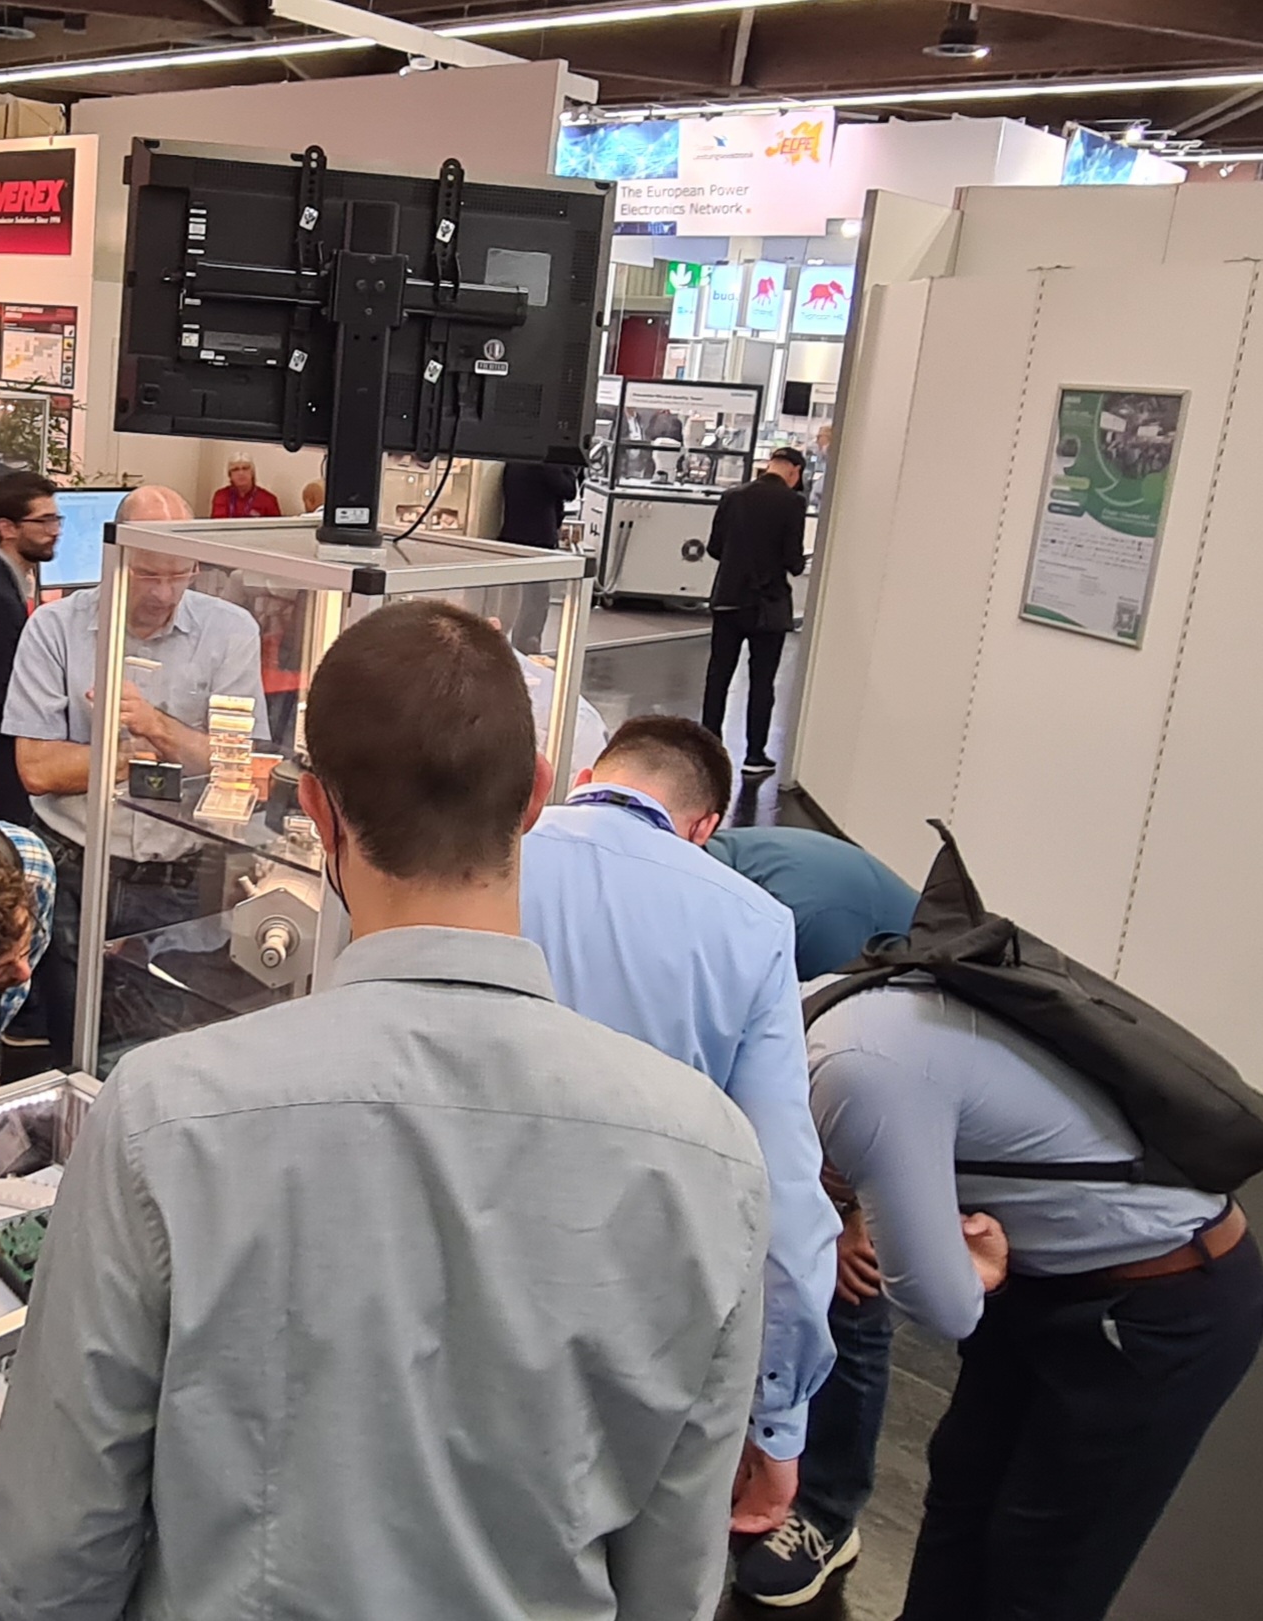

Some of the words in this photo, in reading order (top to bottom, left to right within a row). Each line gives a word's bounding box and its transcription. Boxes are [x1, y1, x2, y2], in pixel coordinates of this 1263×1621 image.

[781, 137, 815, 154] ECPE
[620, 186, 643, 198] The
[647, 186, 705, 200] European
[710, 184, 749, 197] Power
[620, 203, 685, 216] Electronics
[689, 202, 742, 215] Network
